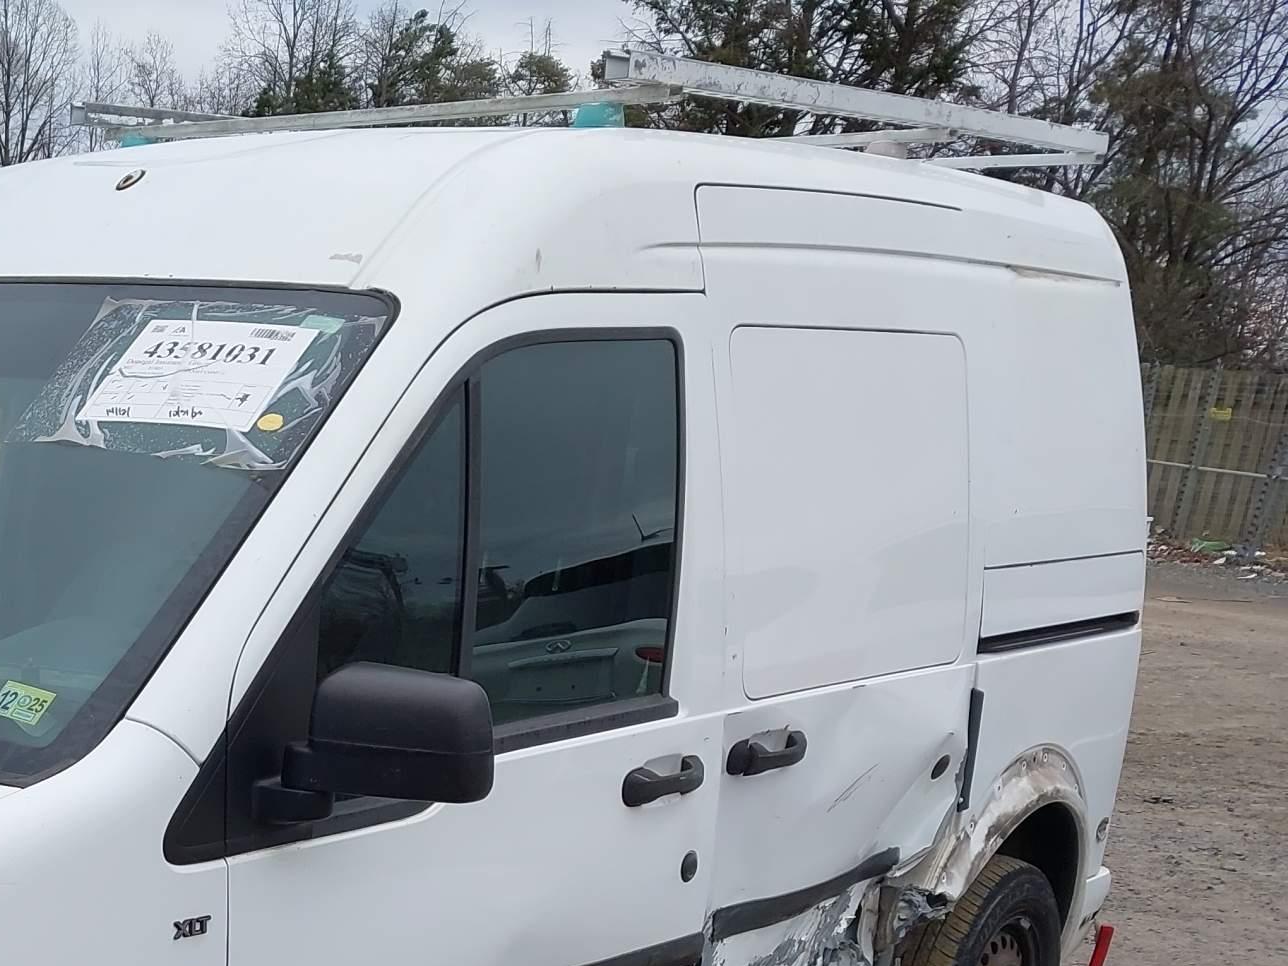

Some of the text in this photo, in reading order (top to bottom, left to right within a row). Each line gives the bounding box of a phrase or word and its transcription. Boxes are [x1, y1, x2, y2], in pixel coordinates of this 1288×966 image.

[144, 340, 277, 366] 43581031
[27, 697, 48, 713] 25
[173, 915, 212, 940] XLT
